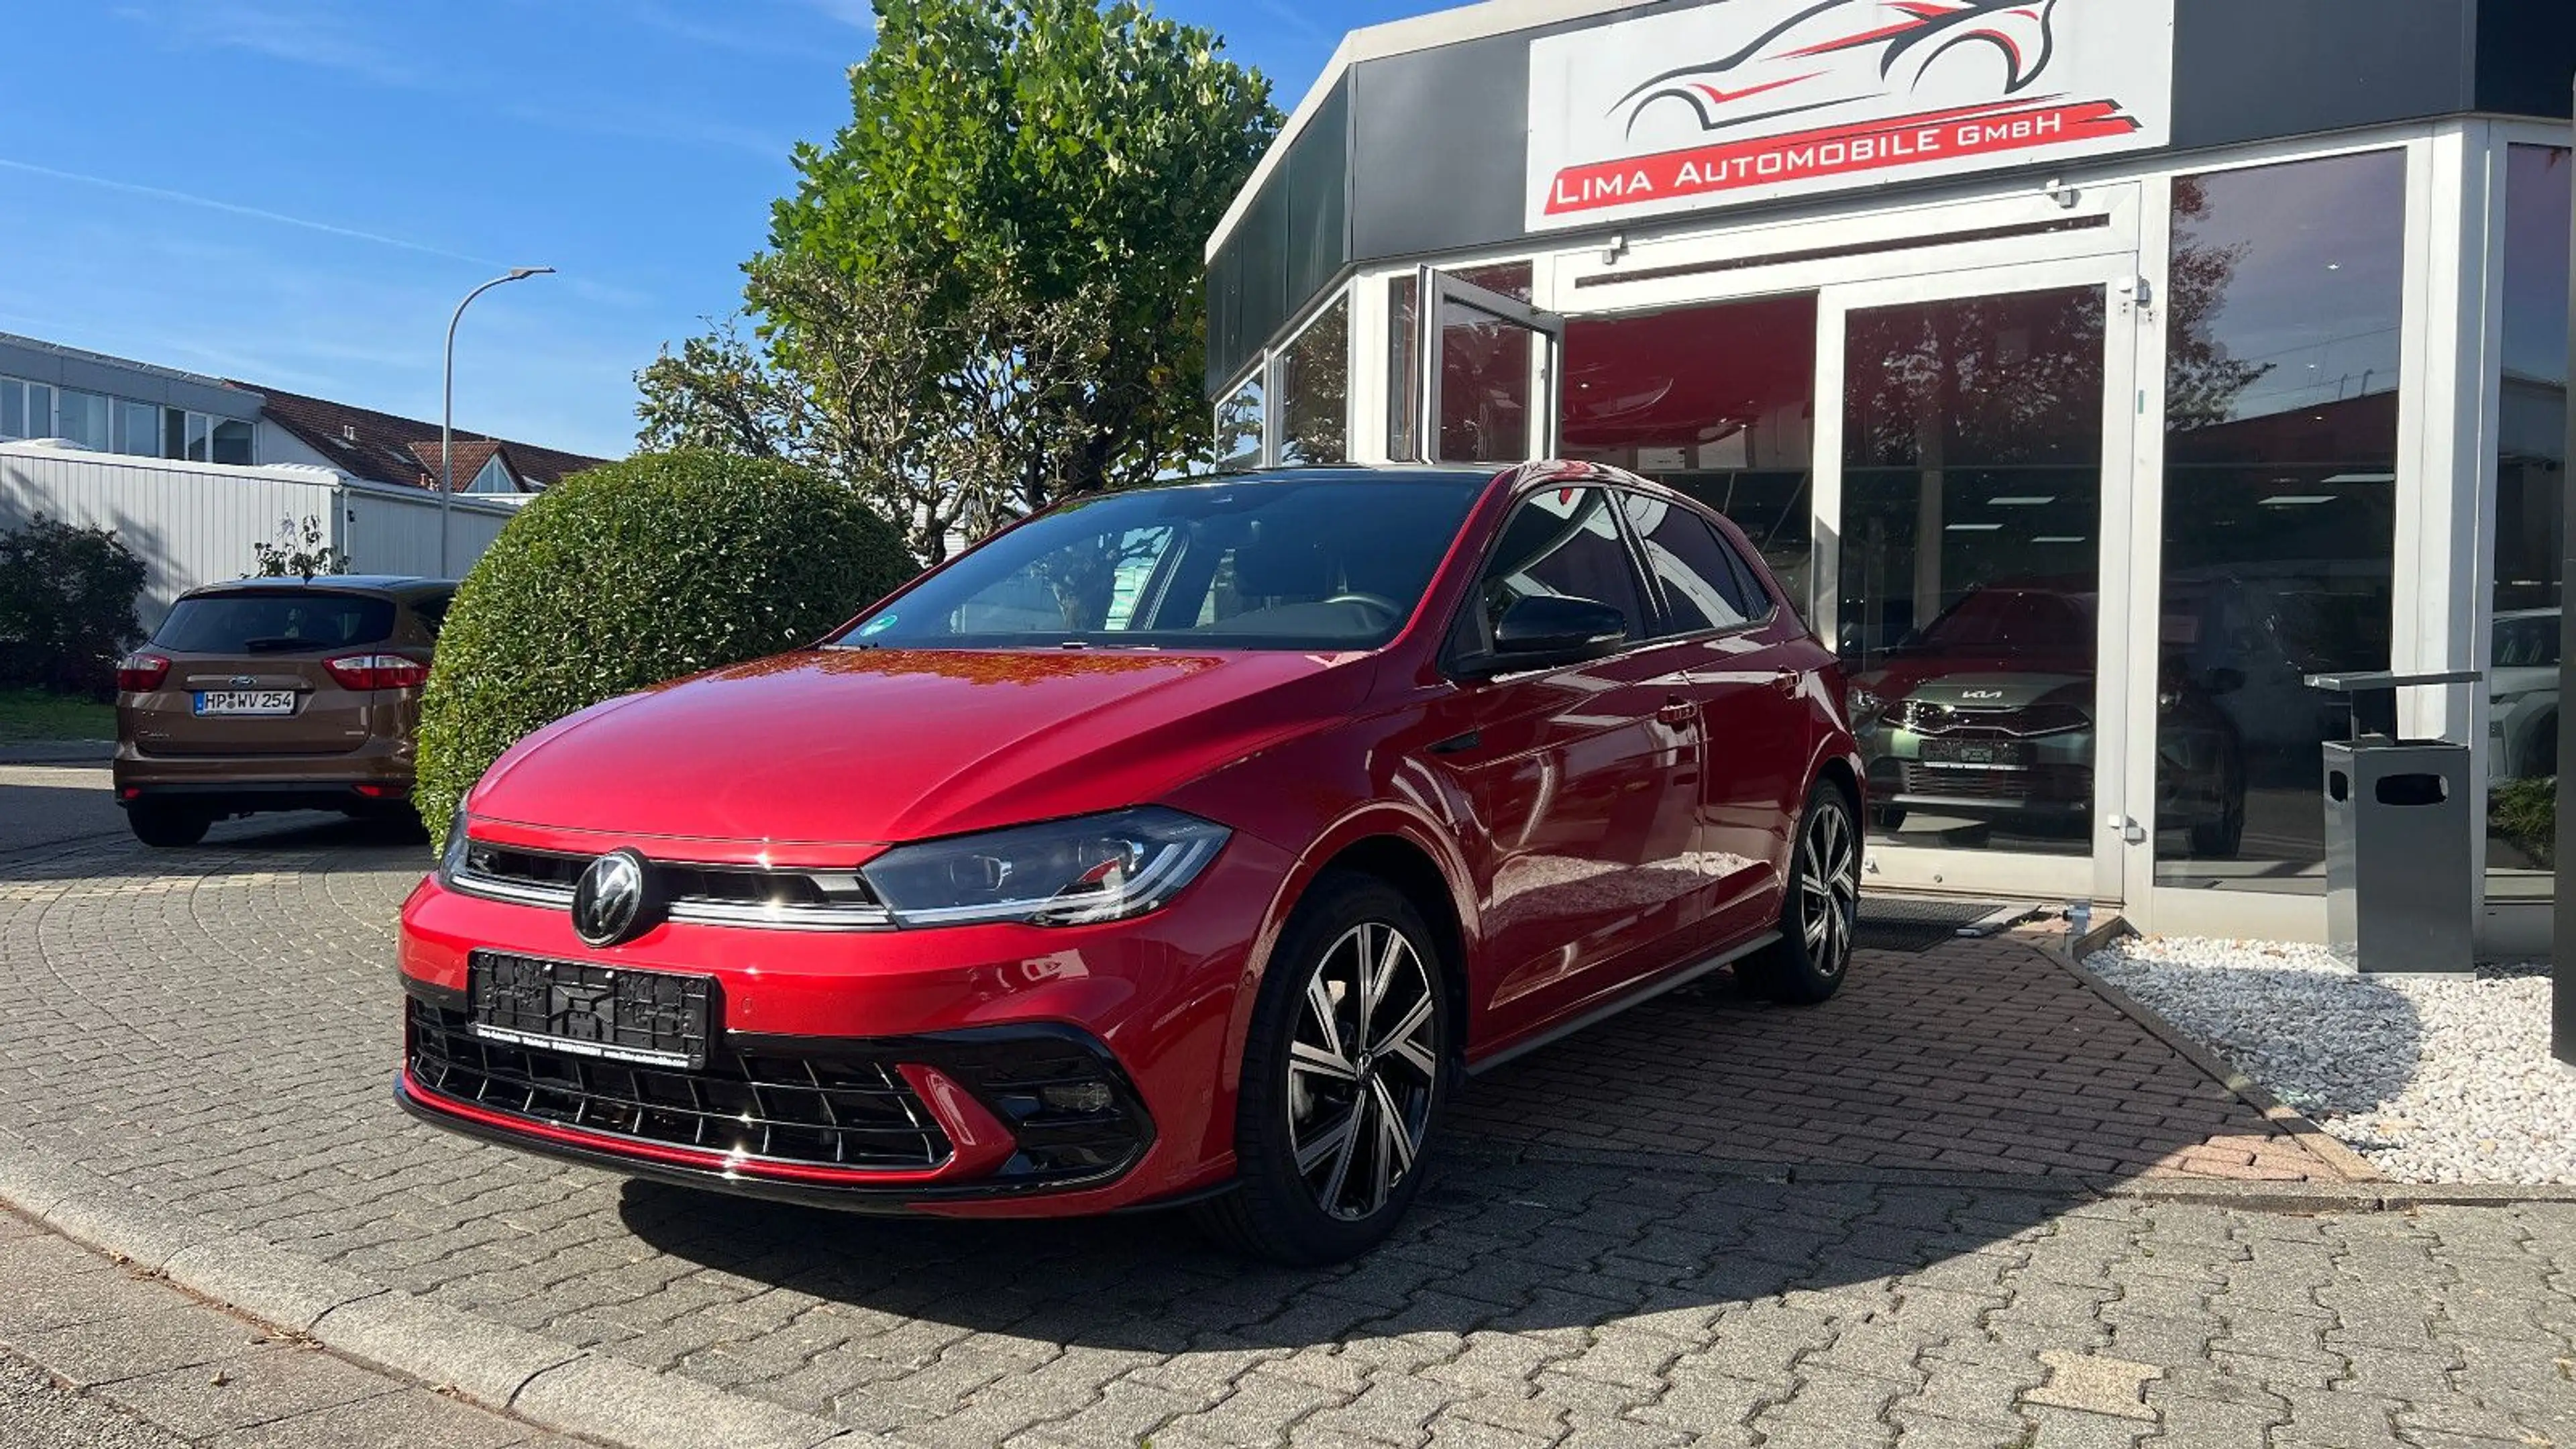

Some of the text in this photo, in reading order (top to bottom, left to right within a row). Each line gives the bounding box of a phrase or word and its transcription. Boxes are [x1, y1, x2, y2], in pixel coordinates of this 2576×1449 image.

[1556, 170, 1653, 205] LIMA
[1674, 129, 1941, 187] AUTOMOBILE
[262, 693, 291, 708] 254
